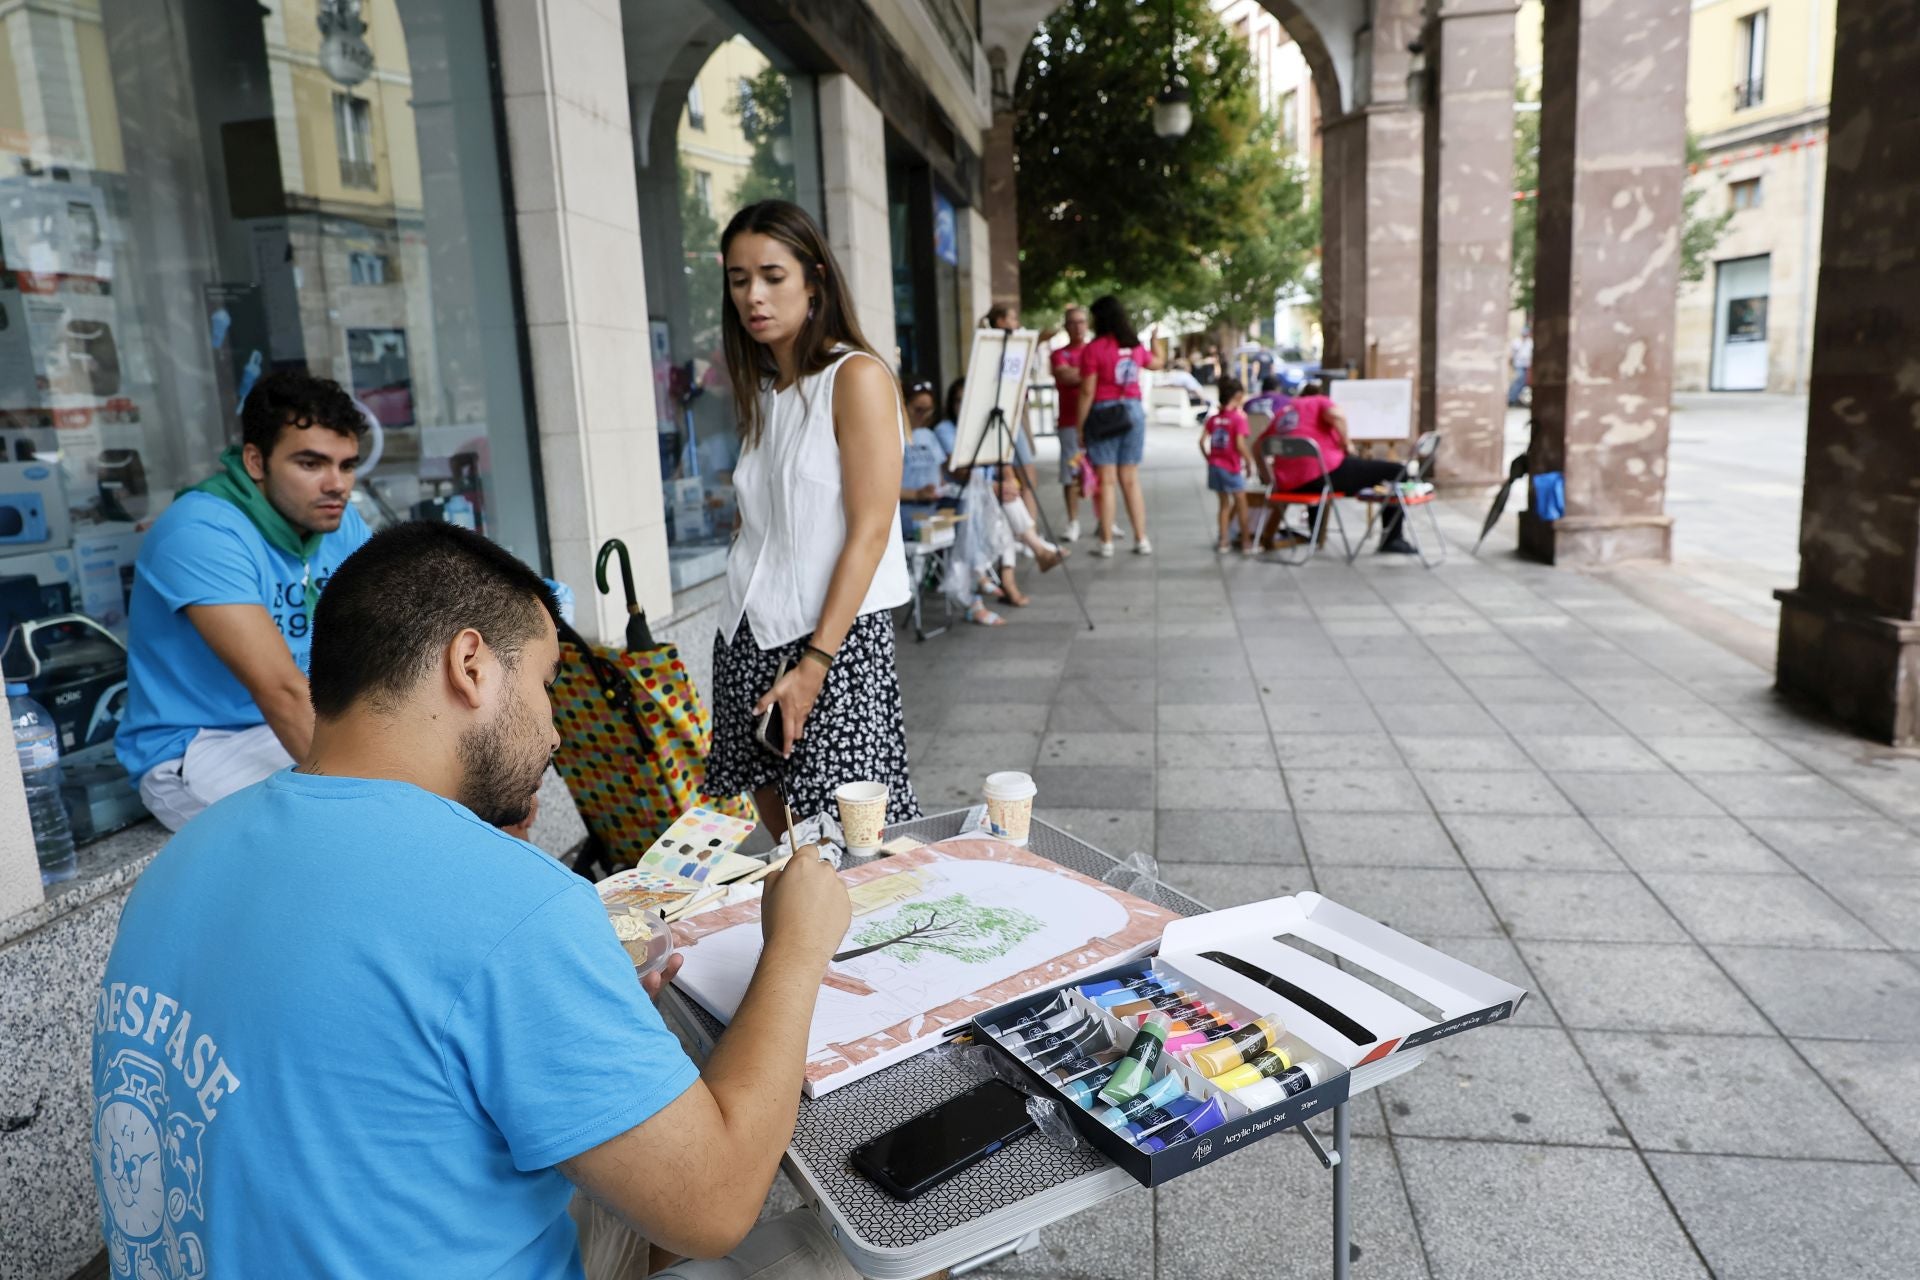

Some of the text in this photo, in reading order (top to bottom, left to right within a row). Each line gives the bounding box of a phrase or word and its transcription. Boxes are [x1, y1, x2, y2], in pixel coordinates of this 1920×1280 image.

[1223, 1112, 1287, 1145] Acrylic Paint Set
